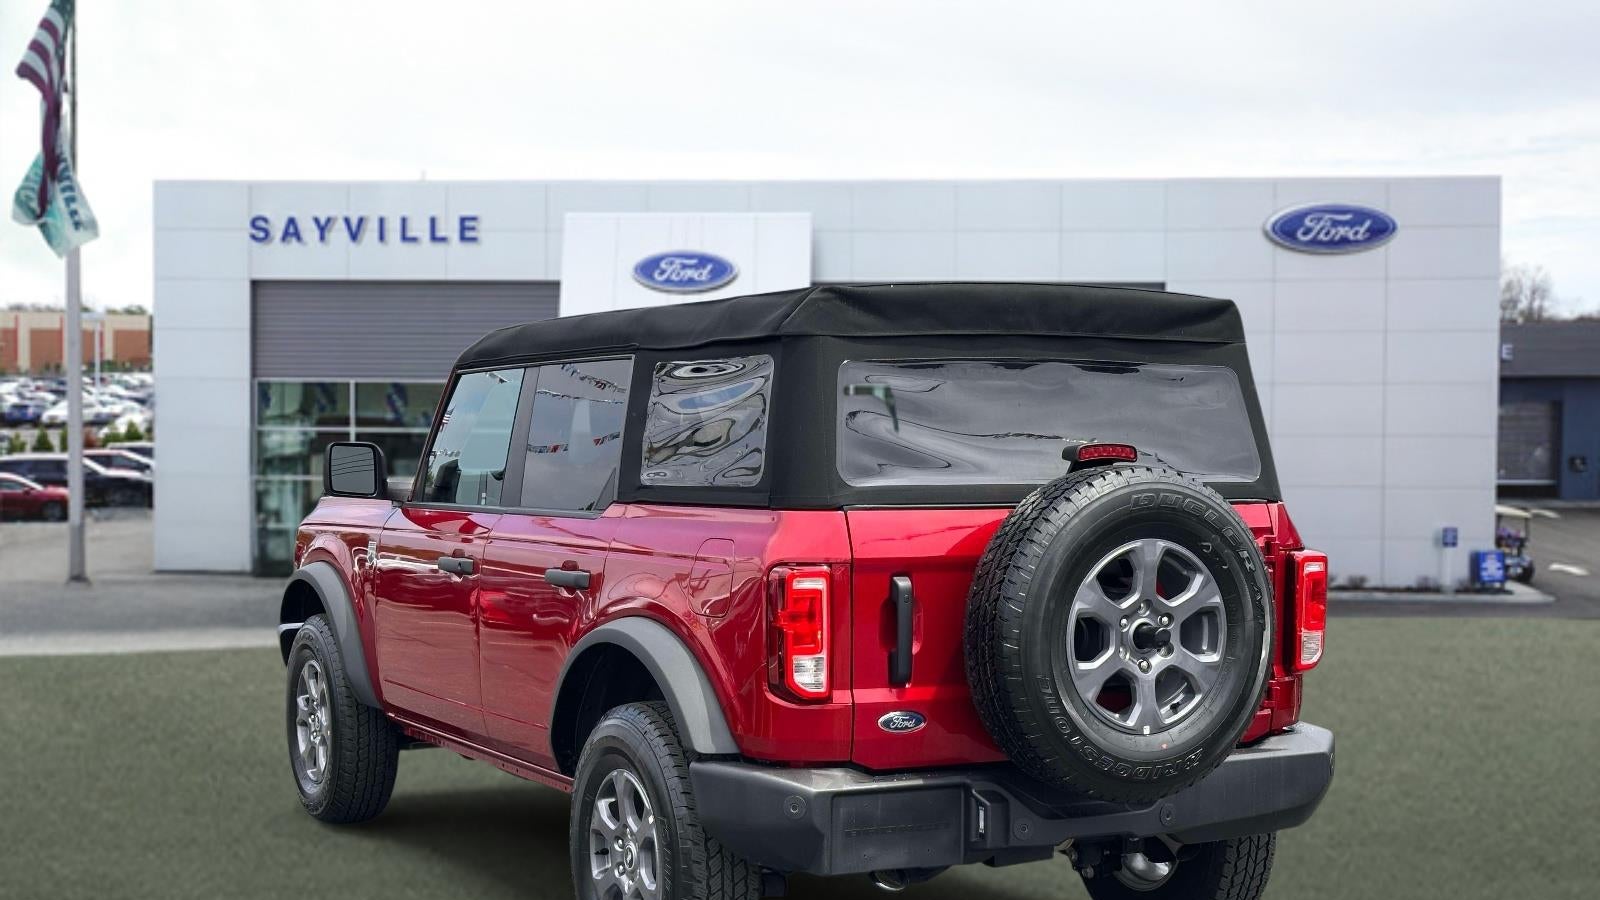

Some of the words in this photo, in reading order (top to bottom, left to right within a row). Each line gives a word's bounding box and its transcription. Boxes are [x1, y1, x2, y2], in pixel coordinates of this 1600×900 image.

[249, 214, 480, 243] SAYVILLE
[1296, 211, 1372, 241] Ford
[653, 256, 714, 281] Ford
[1129, 492, 1257, 573] DUELER
[889, 715, 917, 729] Ford
[1036, 675, 1204, 780] BRIDGESTONE
